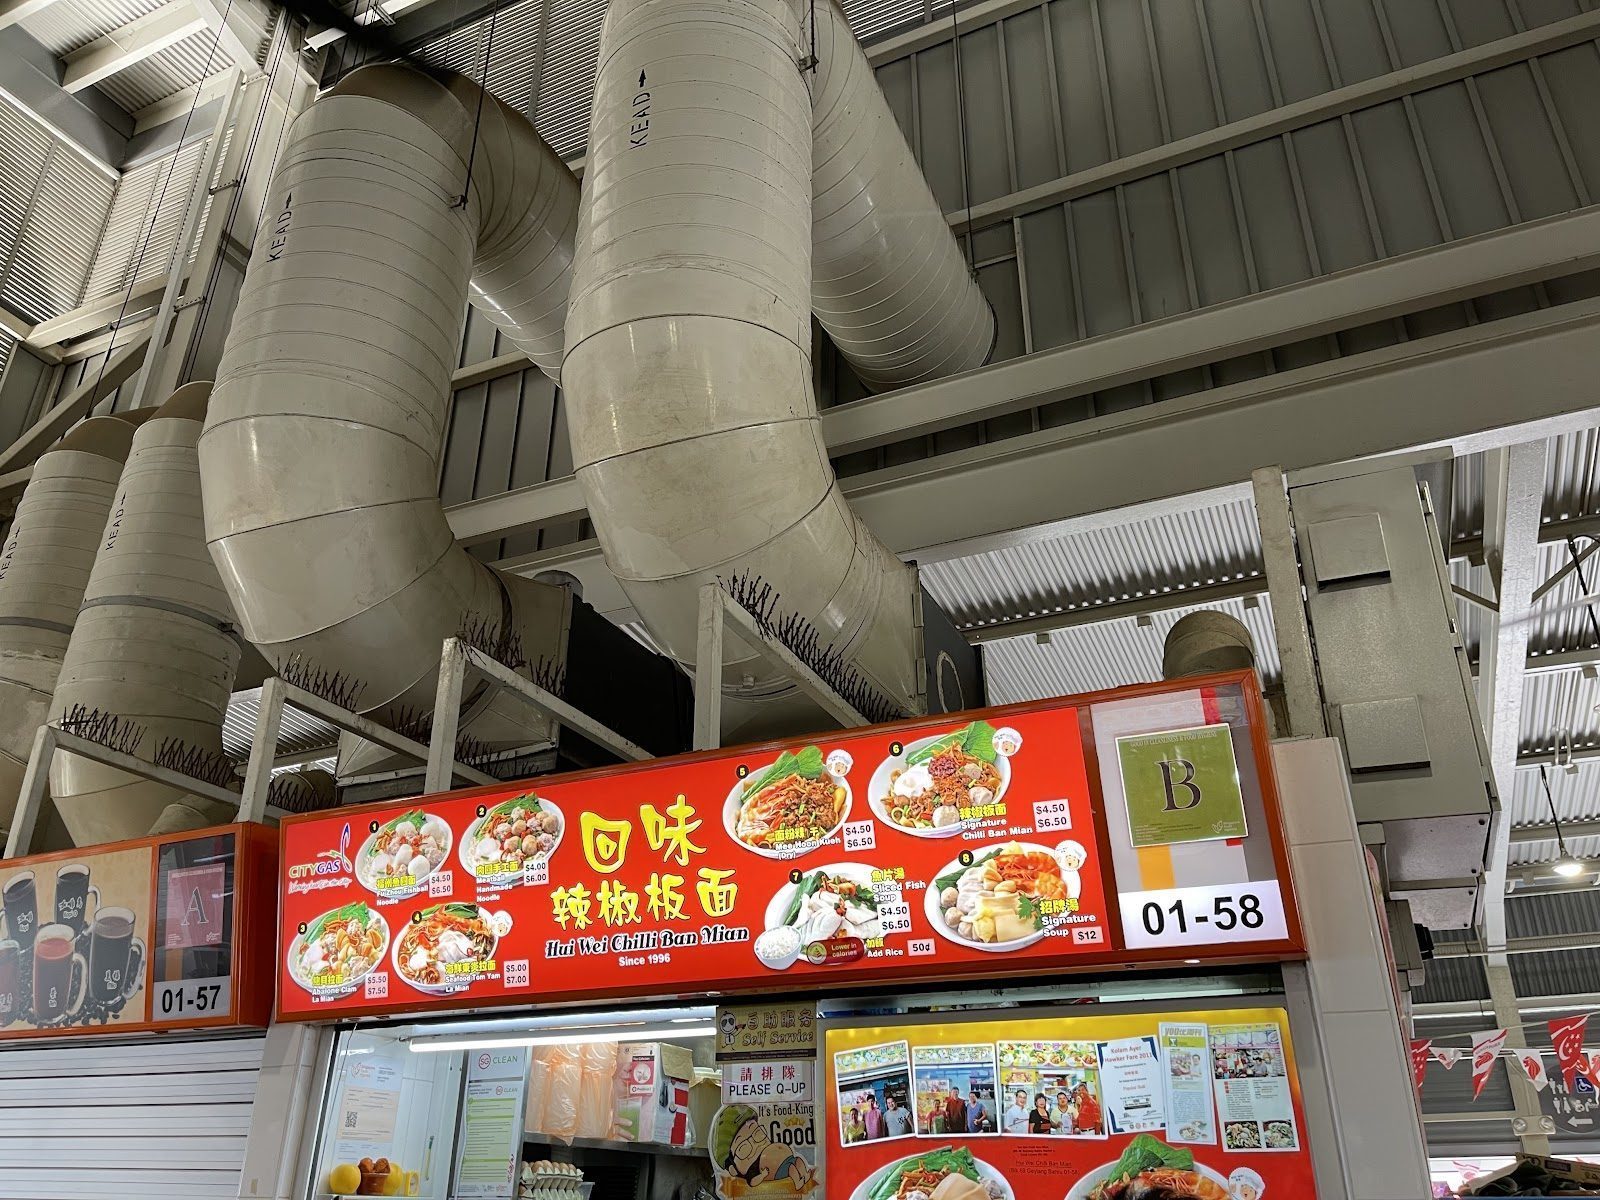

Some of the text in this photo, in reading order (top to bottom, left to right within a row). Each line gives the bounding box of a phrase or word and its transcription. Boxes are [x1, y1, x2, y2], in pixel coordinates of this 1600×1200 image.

[629, 92, 651, 150] KEAD
[266, 211, 292, 263] KEAD
[105, 508, 124, 551] KEAD
[892, 744, 900, 754] 6
[739, 767, 746, 777] 5
[1155, 758, 1202, 813] B
[478, 807, 485, 816] 2
[1036, 803, 1065, 815] $4.50
[371, 823, 378, 831] 1
[961, 818, 1007, 830] Signature
[1037, 816, 1067, 828] $6.50
[580, 793, 707, 874] 回味
[845, 824, 871, 836] $4.50
[962, 825, 1033, 840] Chilli Ban Mian
[795, 839, 817, 849] Hoon
[847, 837, 873, 848] $6.50
[962, 853, 970, 862] 8
[289, 860, 341, 878] CITYGAS
[525, 862, 546, 872] $4.00
[431, 874, 451, 884] $4.50
[525, 873, 547, 883] $6.00
[792, 871, 799, 881] 7
[476, 884, 512, 893] Handmade
[872, 880, 926, 893] Sliced Fish
[376, 899, 399, 907] Noodle
[476, 894, 500, 902] Noodle
[550, 867, 738, 931] 辣椒板面
[873, 893, 897, 902] Soup
[181, 886, 209, 926] A
[880, 906, 908, 916] $4.50
[414, 913, 420, 922] 4
[1041, 913, 1096, 927] Signature
[1142, 893, 1265, 936] 01-58
[300, 924, 306, 933] 3
[882, 920, 910, 931] $6.50
[1043, 928, 1069, 938] Soup
[1077, 930, 1097, 941] $12
[546, 924, 749, 958] Hui Wei Chilli Ban Mian
[831, 943, 850, 951] Lower
[867, 948, 904, 957] Add Rice
[618, 953, 671, 967] Since 1996
[506, 964, 527, 972] $5.00
[367, 976, 387, 984] $5.50
[445, 972, 501, 983] Seafood Tom Yam
[506, 975, 527, 984] $7.00
[367, 987, 386, 995] $7.50
[162, 984, 222, 1014] 01-57
[742, 1029, 814, 1048] Self Service
[492, 1055, 518, 1065] CLEAN
[740, 1065, 796, 1082] 請排隊
[729, 1082, 806, 1097] PLEASE Q-UP
[758, 1103, 814, 1117] It's Food-King
[769, 1118, 816, 1146] Good
